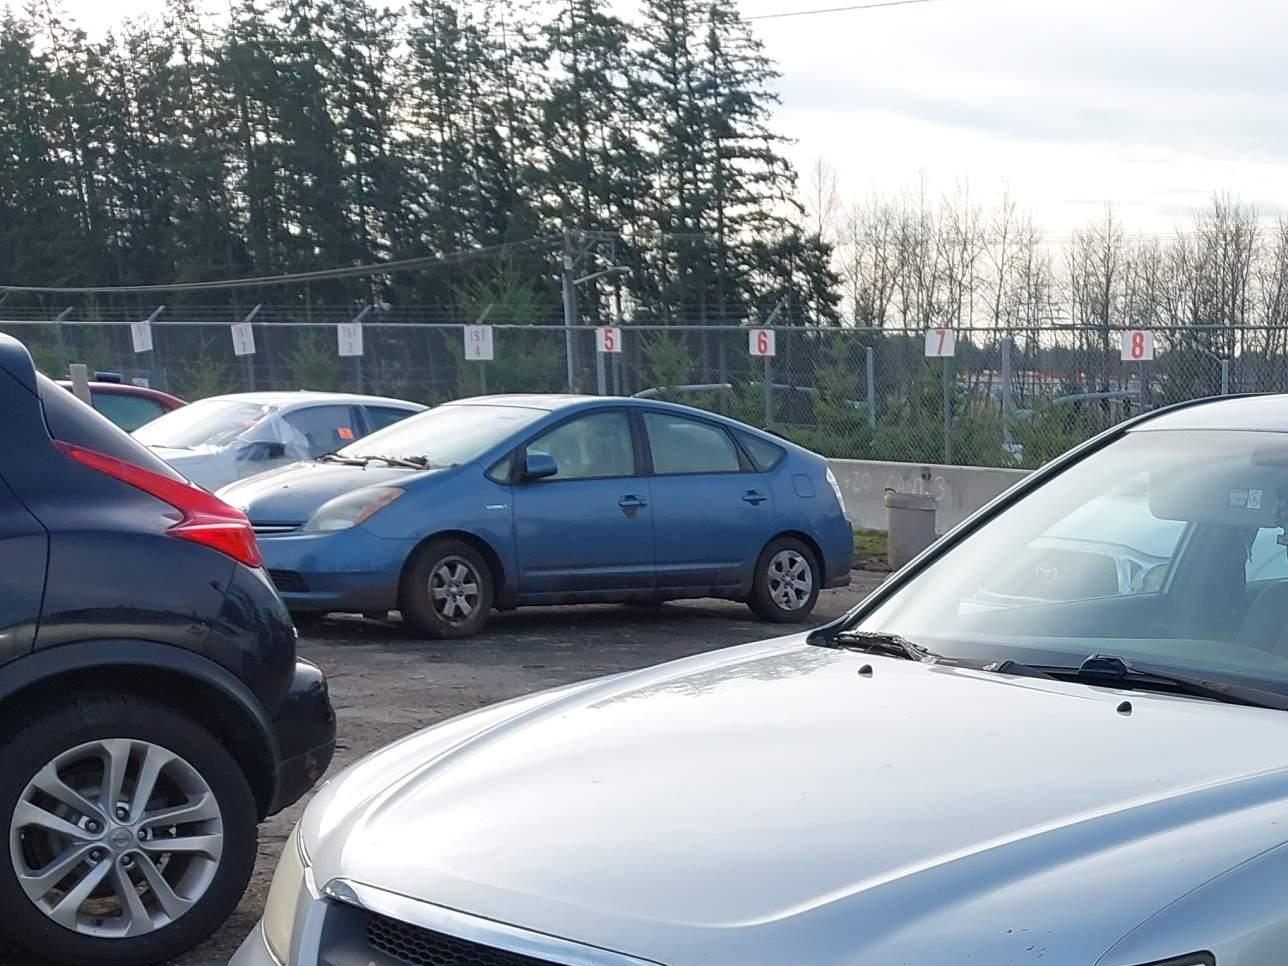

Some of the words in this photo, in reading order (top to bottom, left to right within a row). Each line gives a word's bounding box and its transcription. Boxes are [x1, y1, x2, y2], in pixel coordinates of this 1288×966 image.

[604, 329, 613, 351] 5
[757, 331, 767, 353] 6
[936, 331, 945, 355] 7
[1131, 332, 1144, 359] 8
